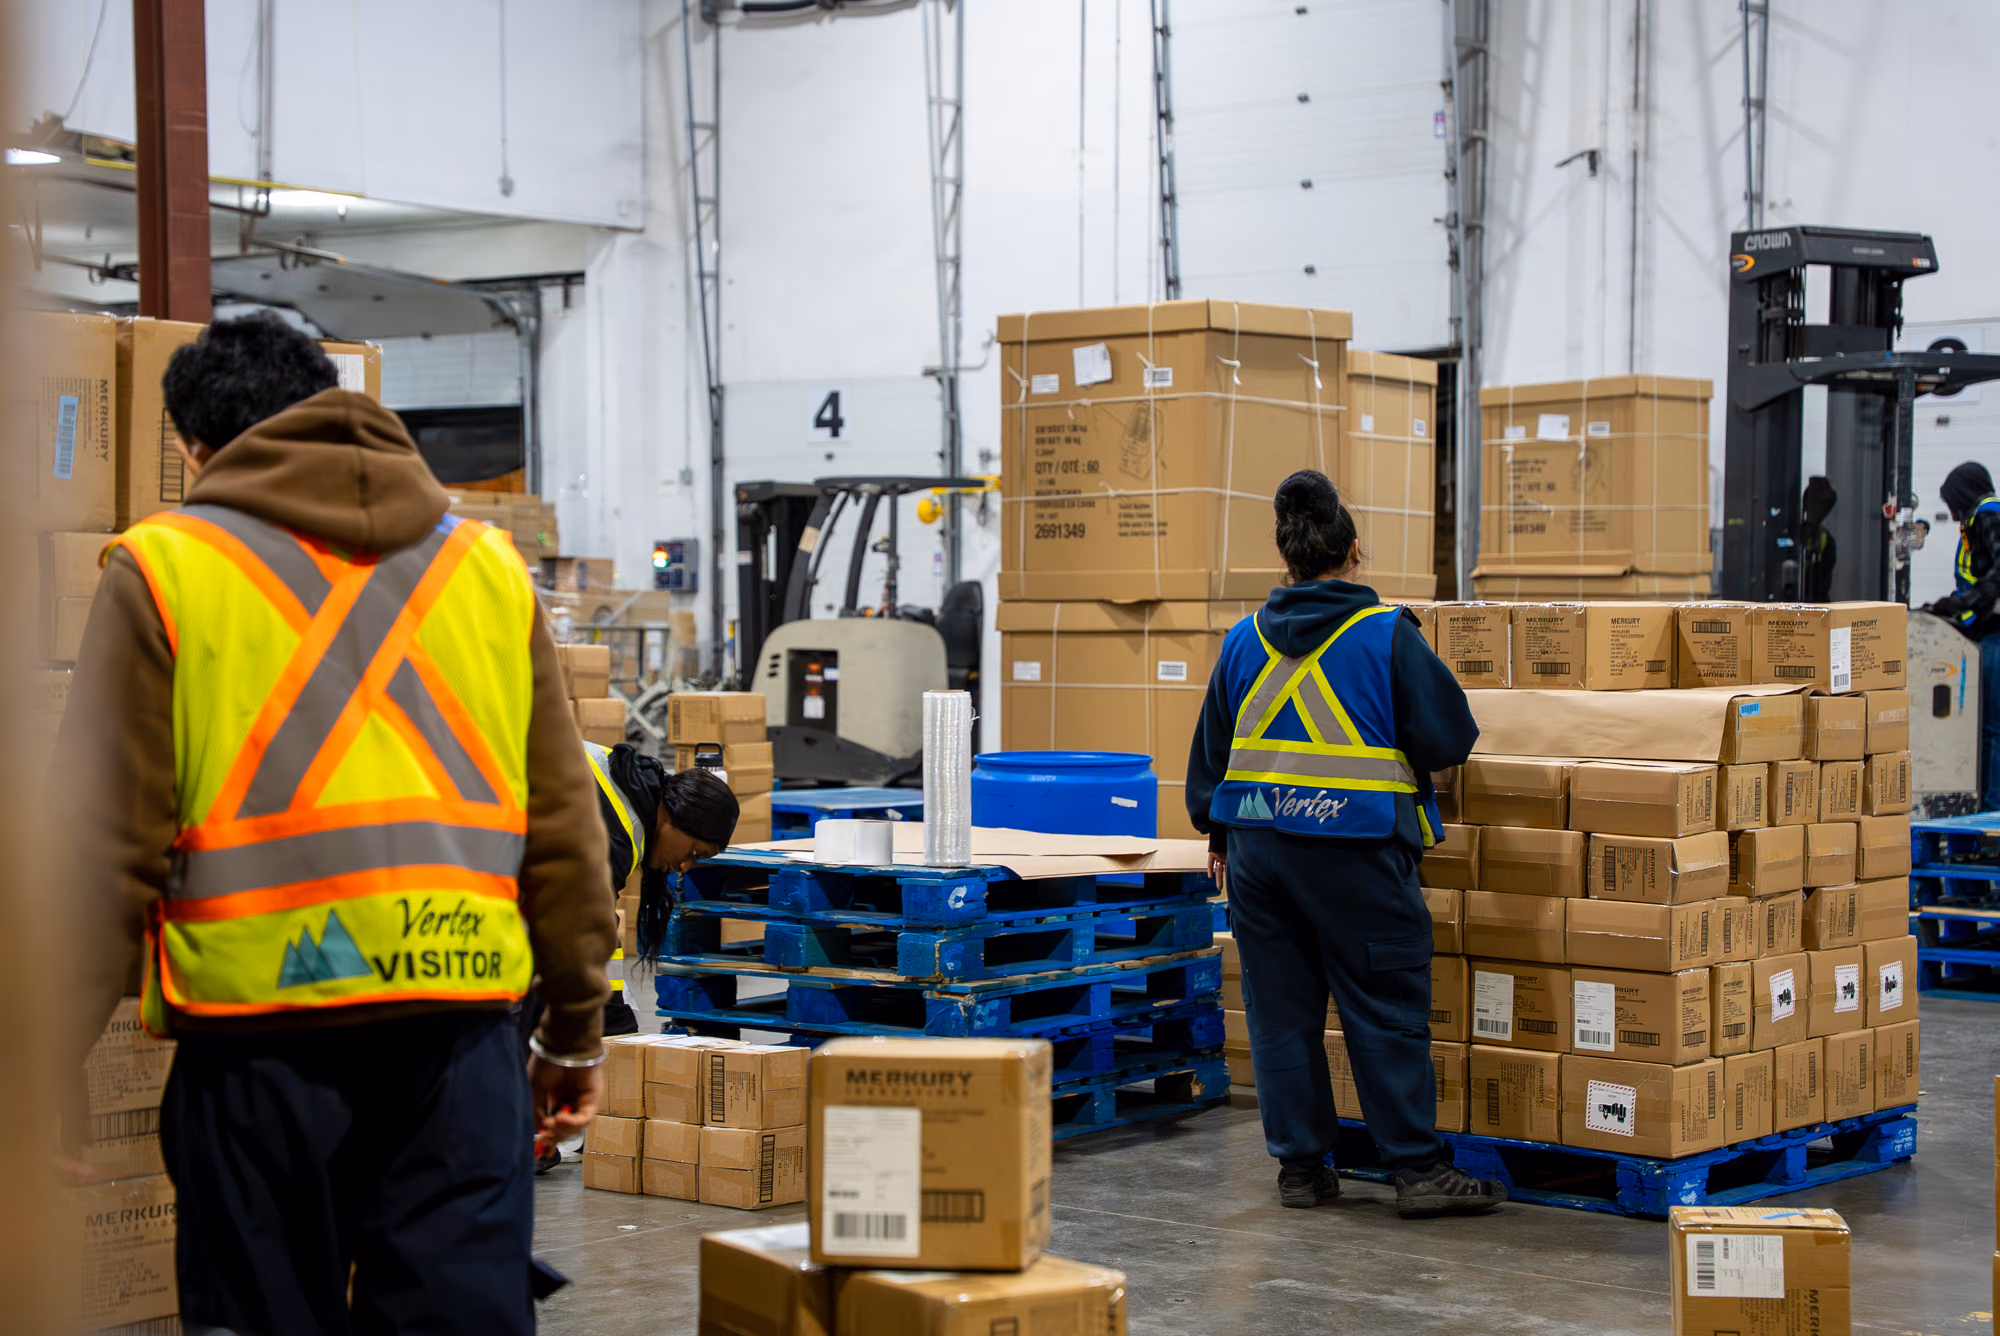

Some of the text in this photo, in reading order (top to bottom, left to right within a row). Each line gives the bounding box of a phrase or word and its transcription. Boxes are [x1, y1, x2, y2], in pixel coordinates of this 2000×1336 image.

[99, 379, 109, 462] MERKURY
[813, 390, 844, 438] 4
[1034, 523, 1086, 539] 2691349
[1610, 617, 1641, 625] MERKURY
[1851, 619, 1878, 628] MERKURY
[1272, 787, 1347, 824] Vertex
[394, 898, 485, 944] Vertex
[373, 950, 501, 982] VISITOR
[846, 1069, 973, 1088] MERKURY
[85, 1202, 177, 1228] MERKUR
[1808, 1288, 1820, 1336] MERK
